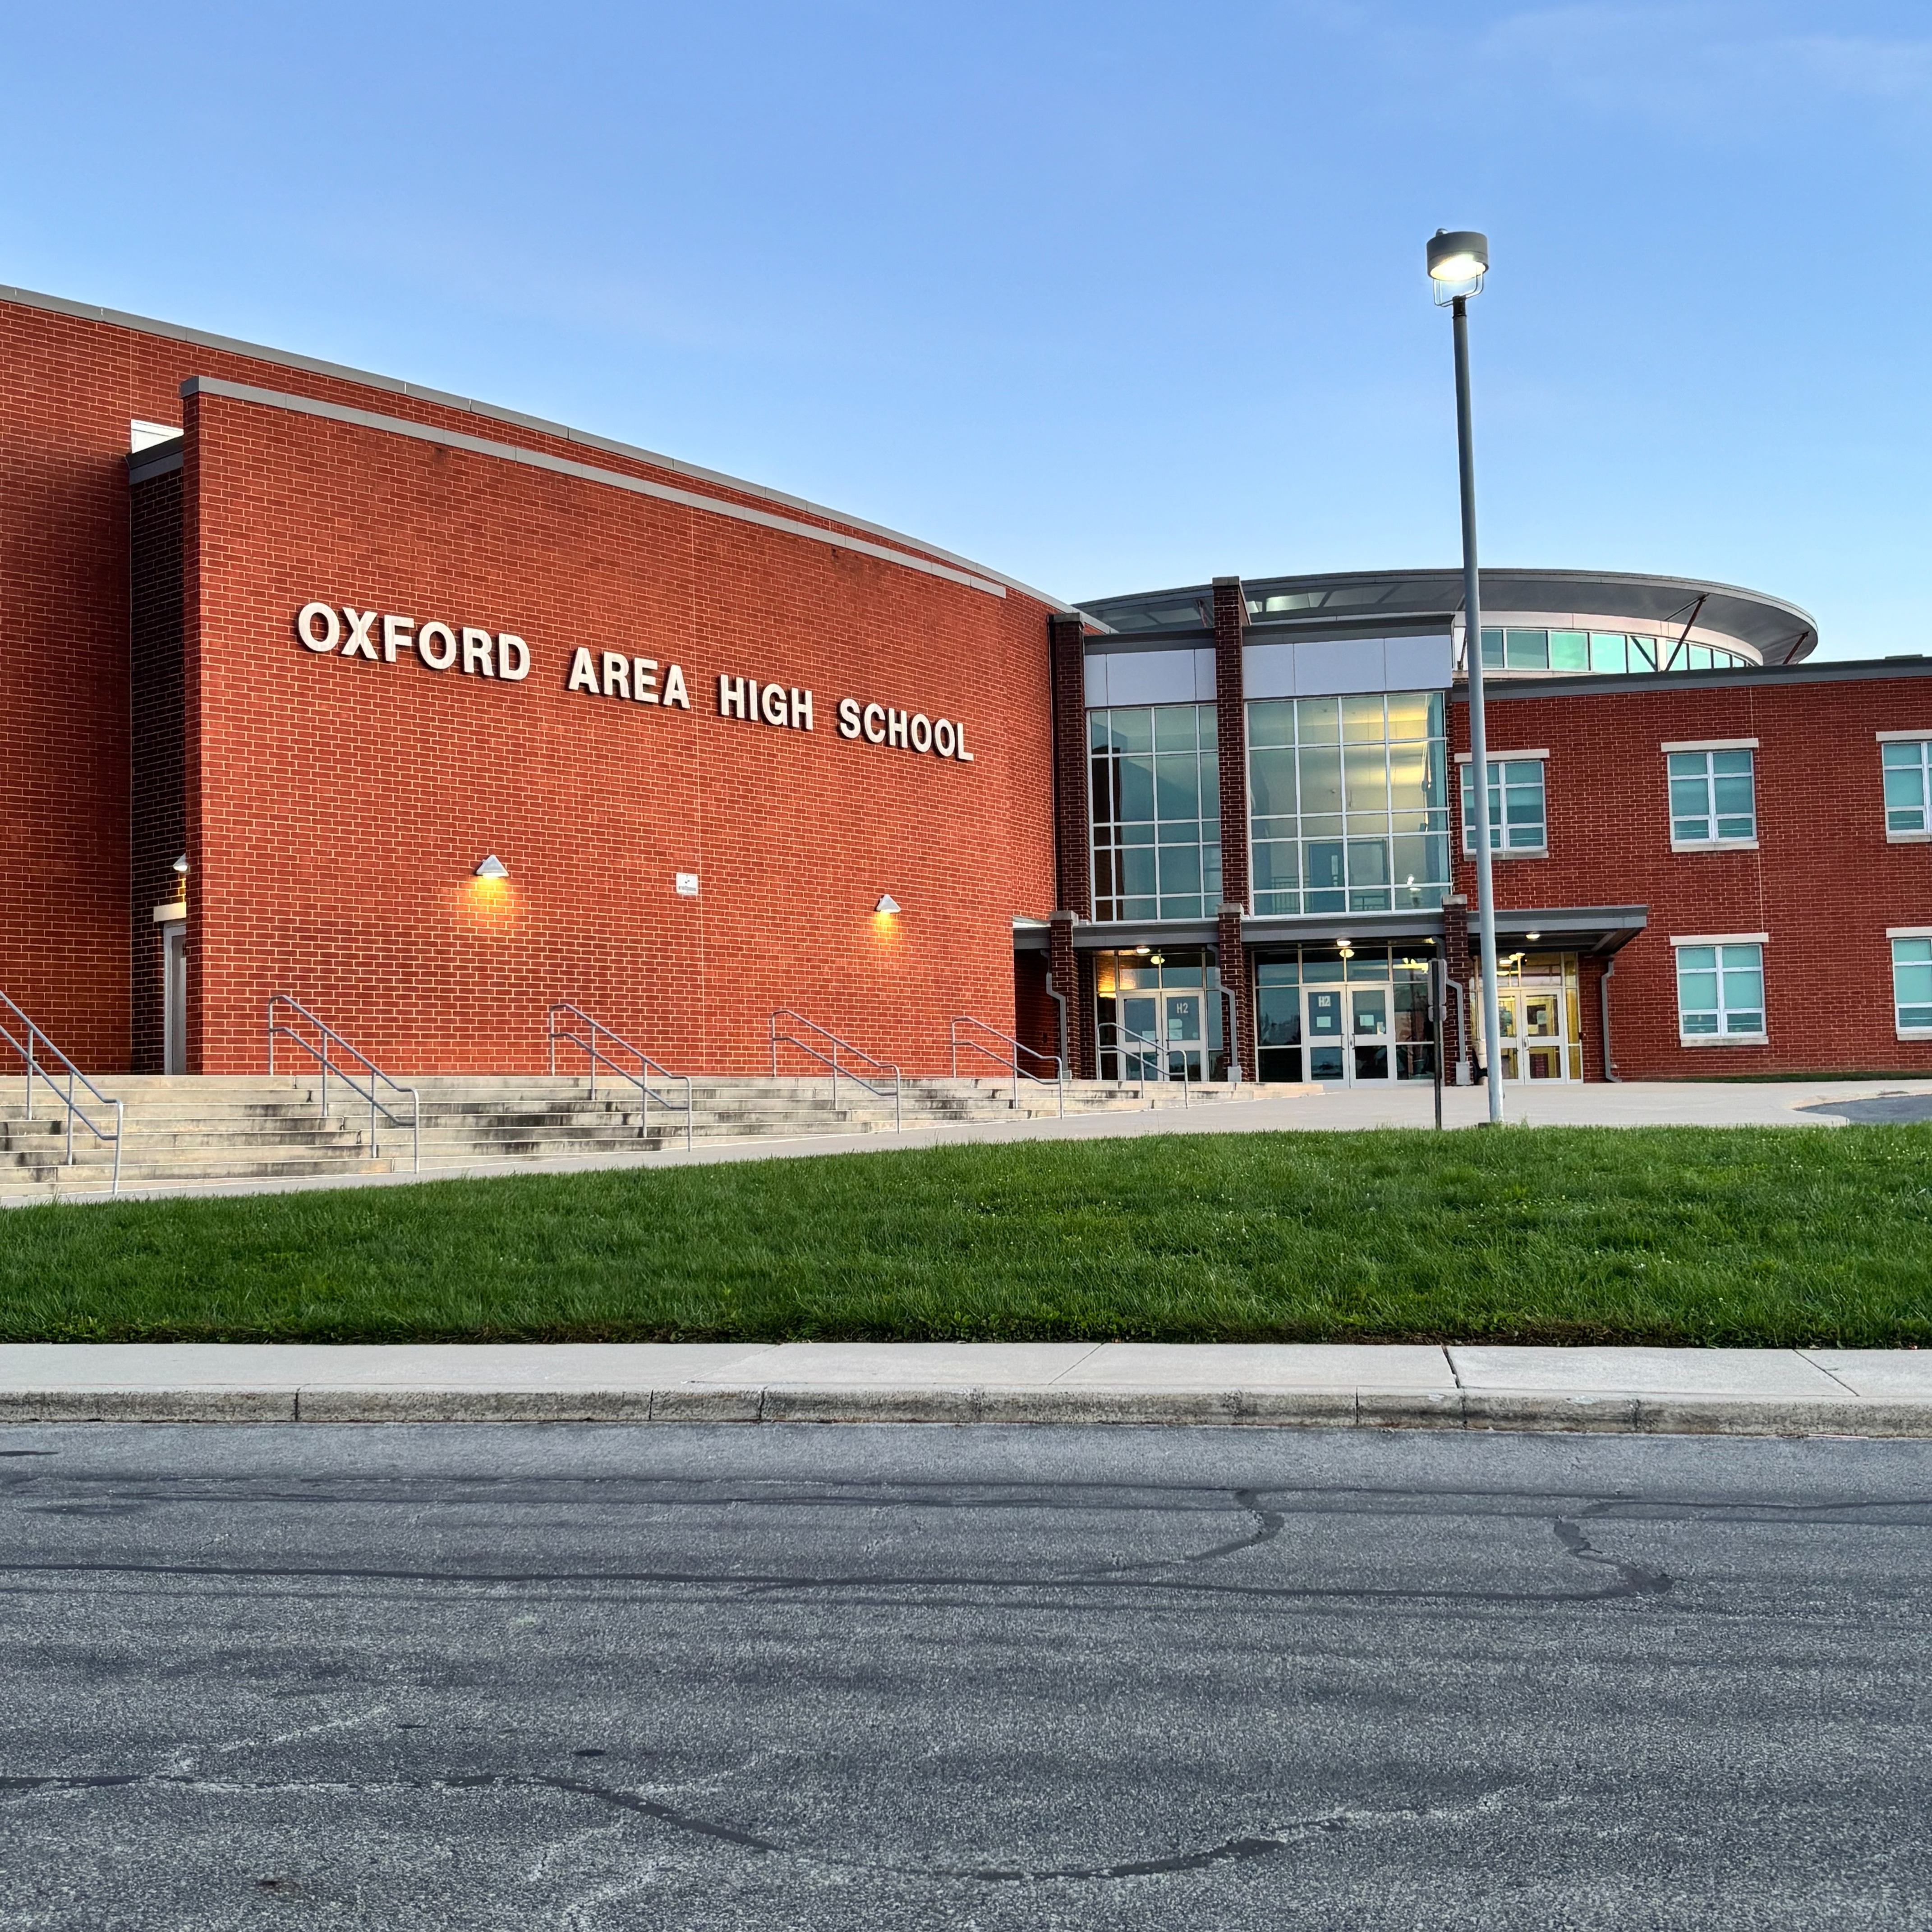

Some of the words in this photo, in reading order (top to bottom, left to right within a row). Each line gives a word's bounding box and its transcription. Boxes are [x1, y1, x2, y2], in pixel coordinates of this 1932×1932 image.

[298, 602, 531, 681] OXFORD
[568, 646, 691, 709] AREA
[720, 674, 814, 731] HIGH
[840, 698, 975, 761] SCHOOL
[1318, 996, 1331, 1007] H2
[1177, 1003, 1188, 1013] H2
